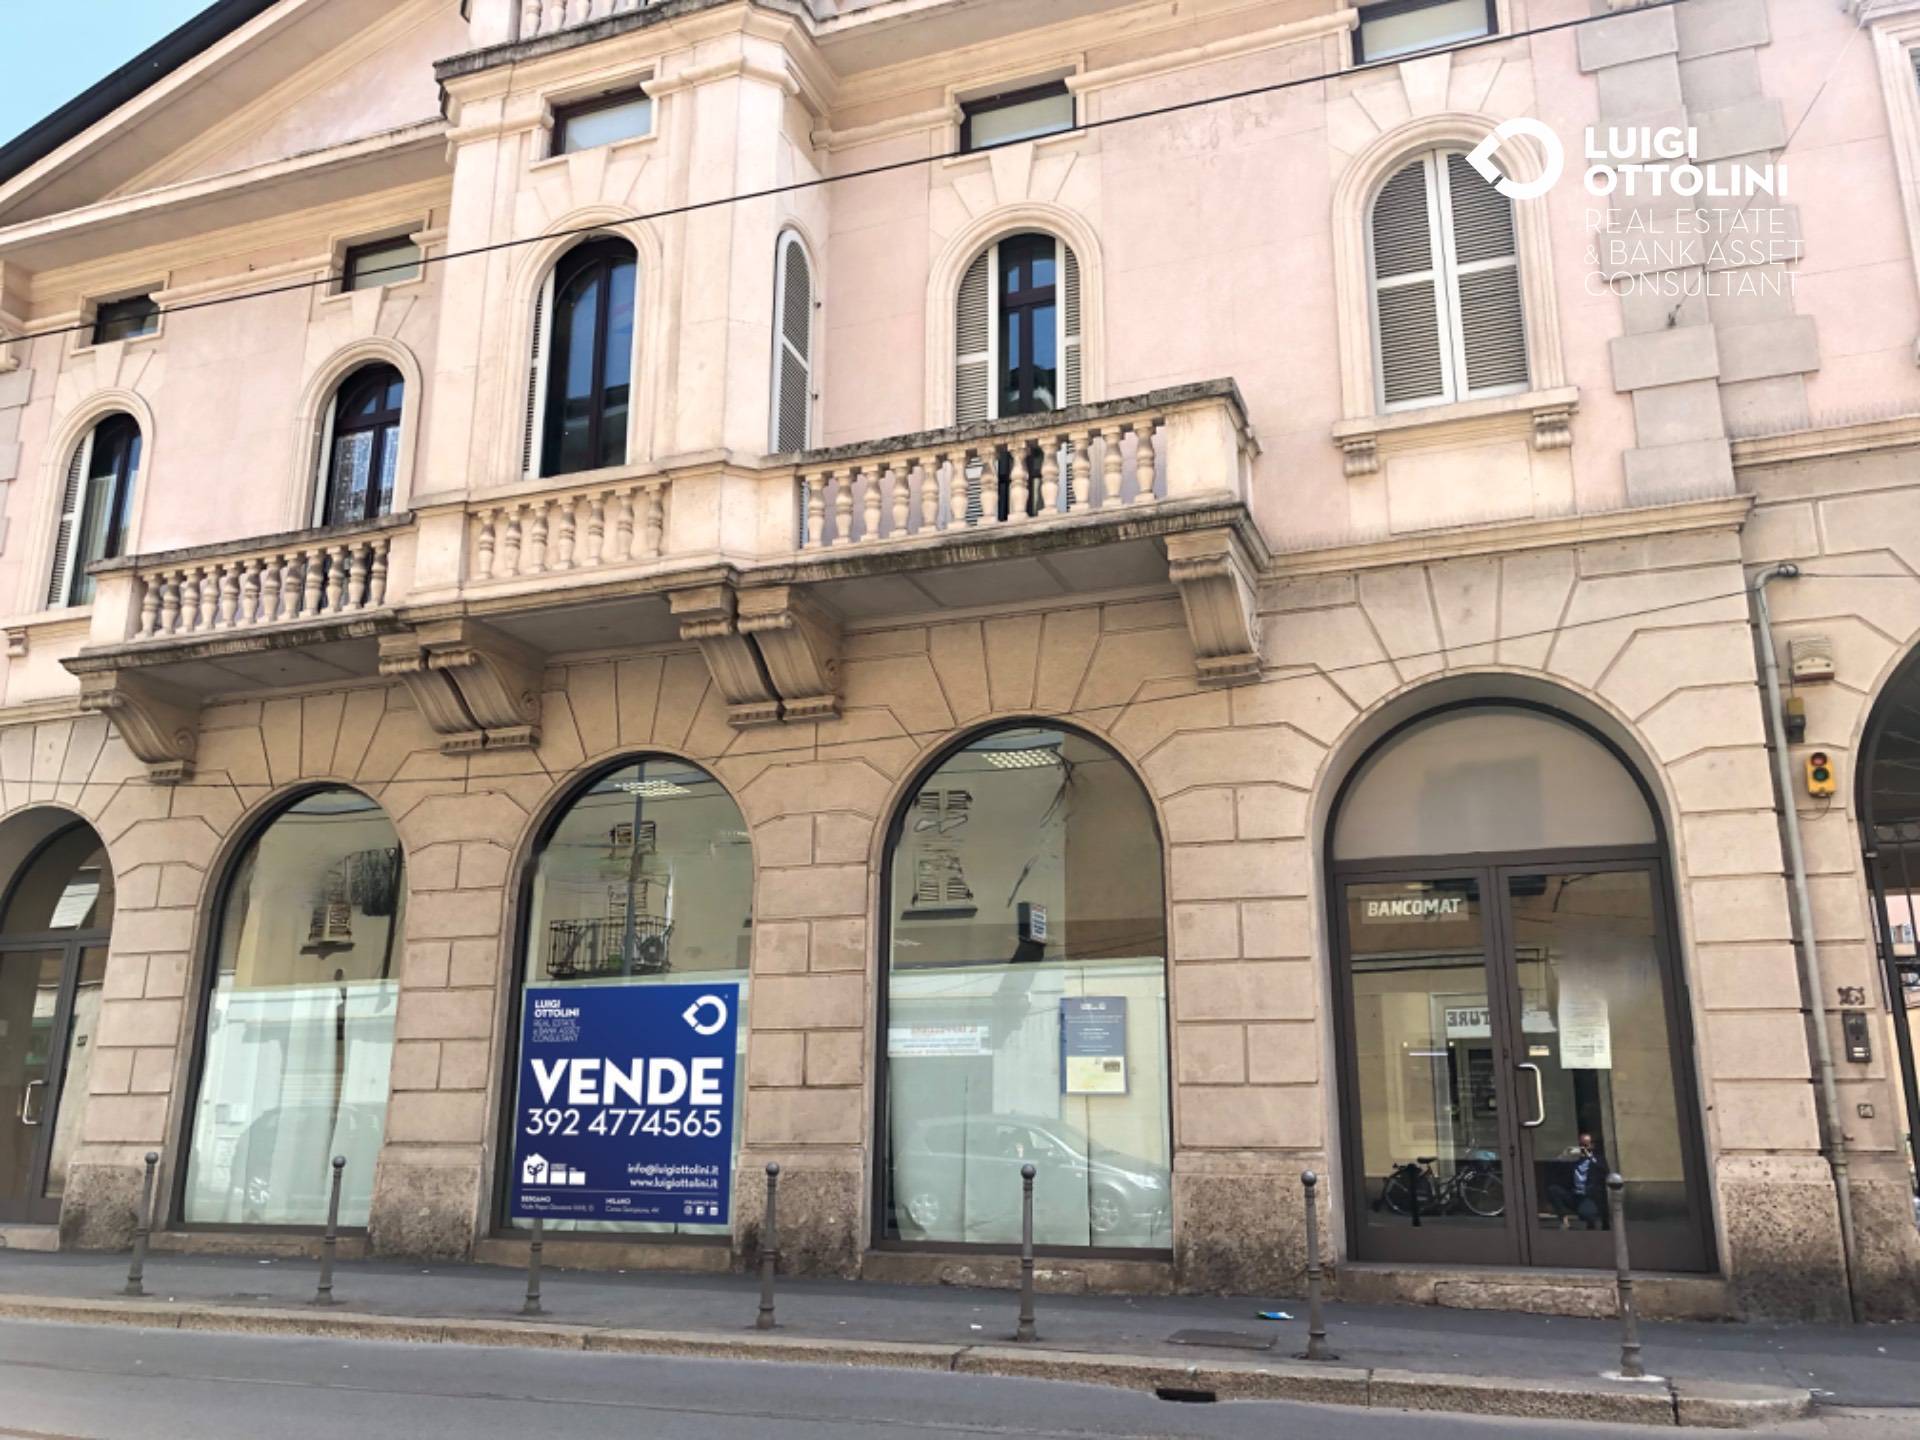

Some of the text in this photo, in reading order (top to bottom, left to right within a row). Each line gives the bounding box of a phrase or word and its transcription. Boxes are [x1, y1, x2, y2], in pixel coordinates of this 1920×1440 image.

[1367, 898, 1461, 917] BANCOMAT
[534, 999, 561, 1008] LUIGI
[534, 1008, 580, 1018] OTTOLINI
[530, 1057, 724, 1106] VENDE
[526, 1108, 722, 1137] 392 4774565
[627, 1163, 719, 1176] info@luigiottolini.it
[630, 1178, 719, 1191] www.luigiottolini.it
